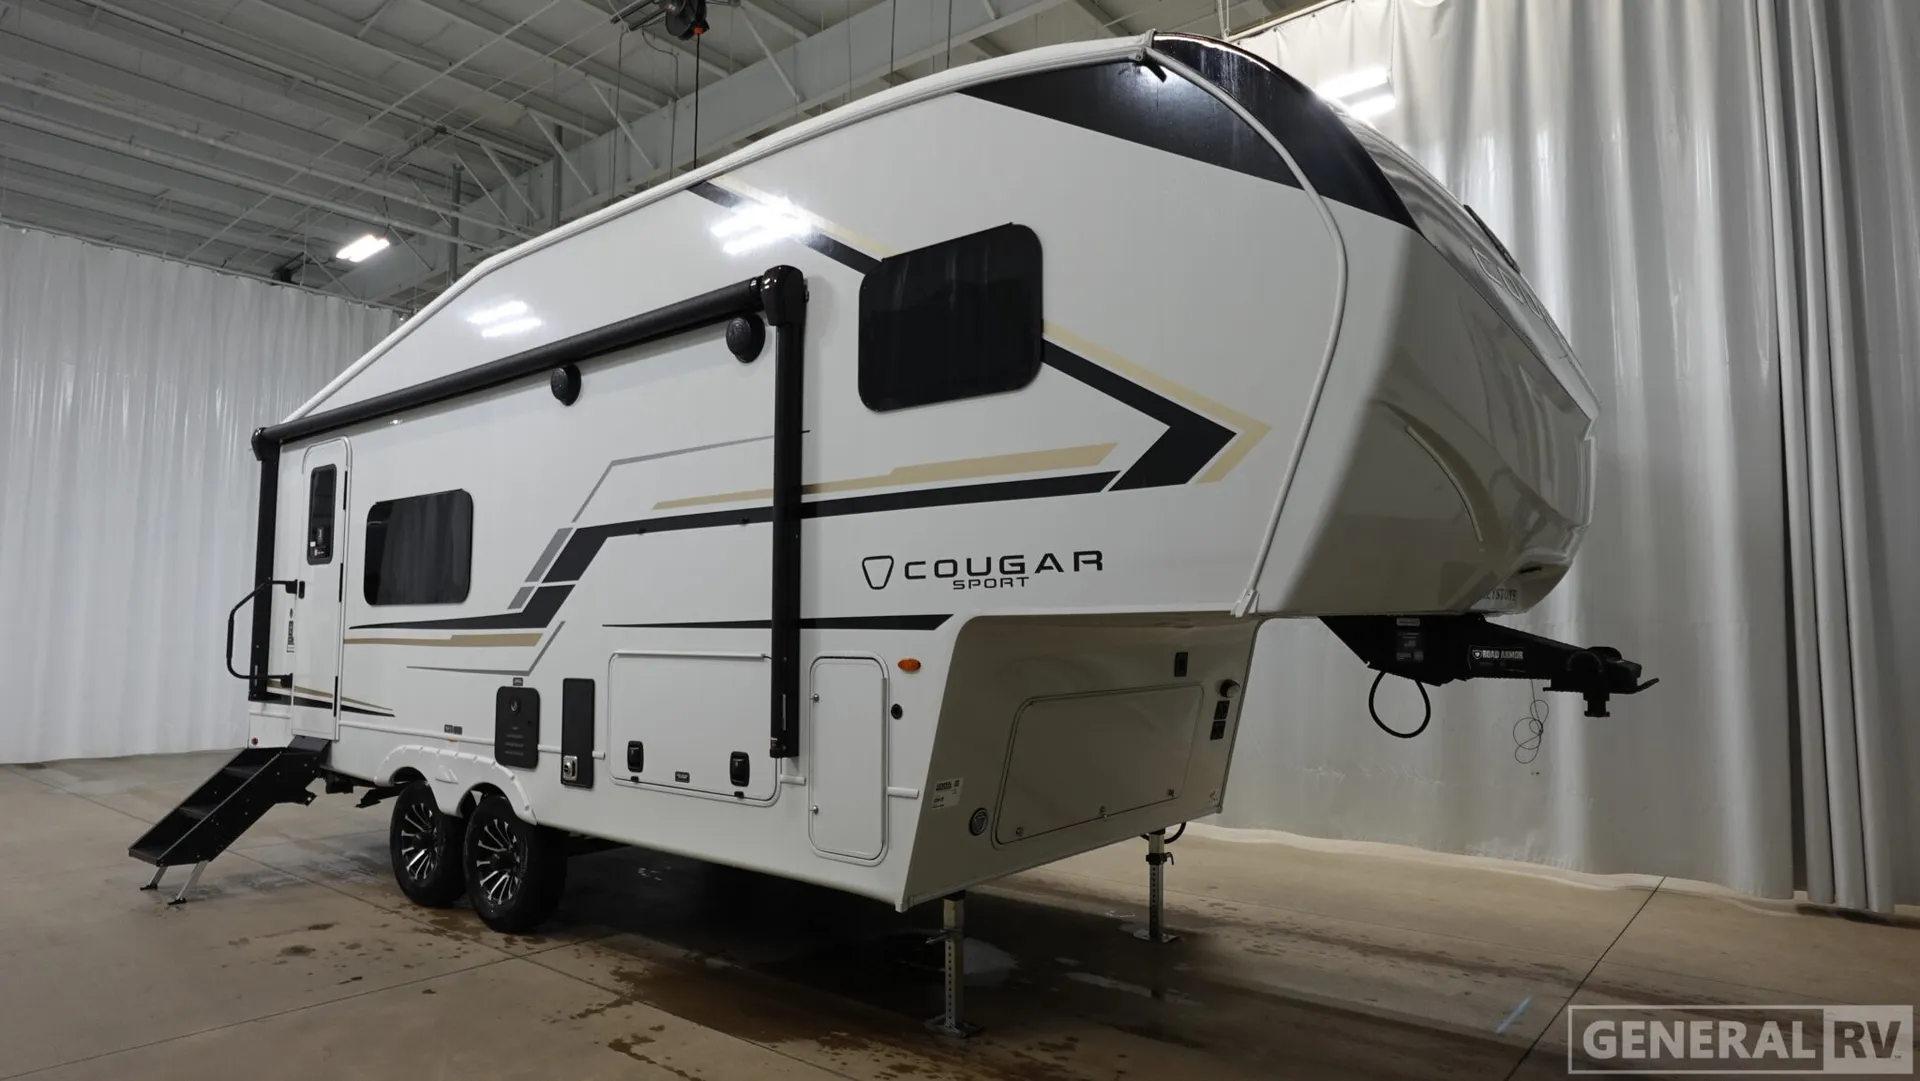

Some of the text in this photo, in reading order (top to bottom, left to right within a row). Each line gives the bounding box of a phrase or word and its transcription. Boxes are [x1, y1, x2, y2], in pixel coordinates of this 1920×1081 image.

[904, 550, 1103, 580] COUGAR
[952, 576, 1029, 590] SPORT
[1482, 649, 1524, 660] ROAD ARMOR
